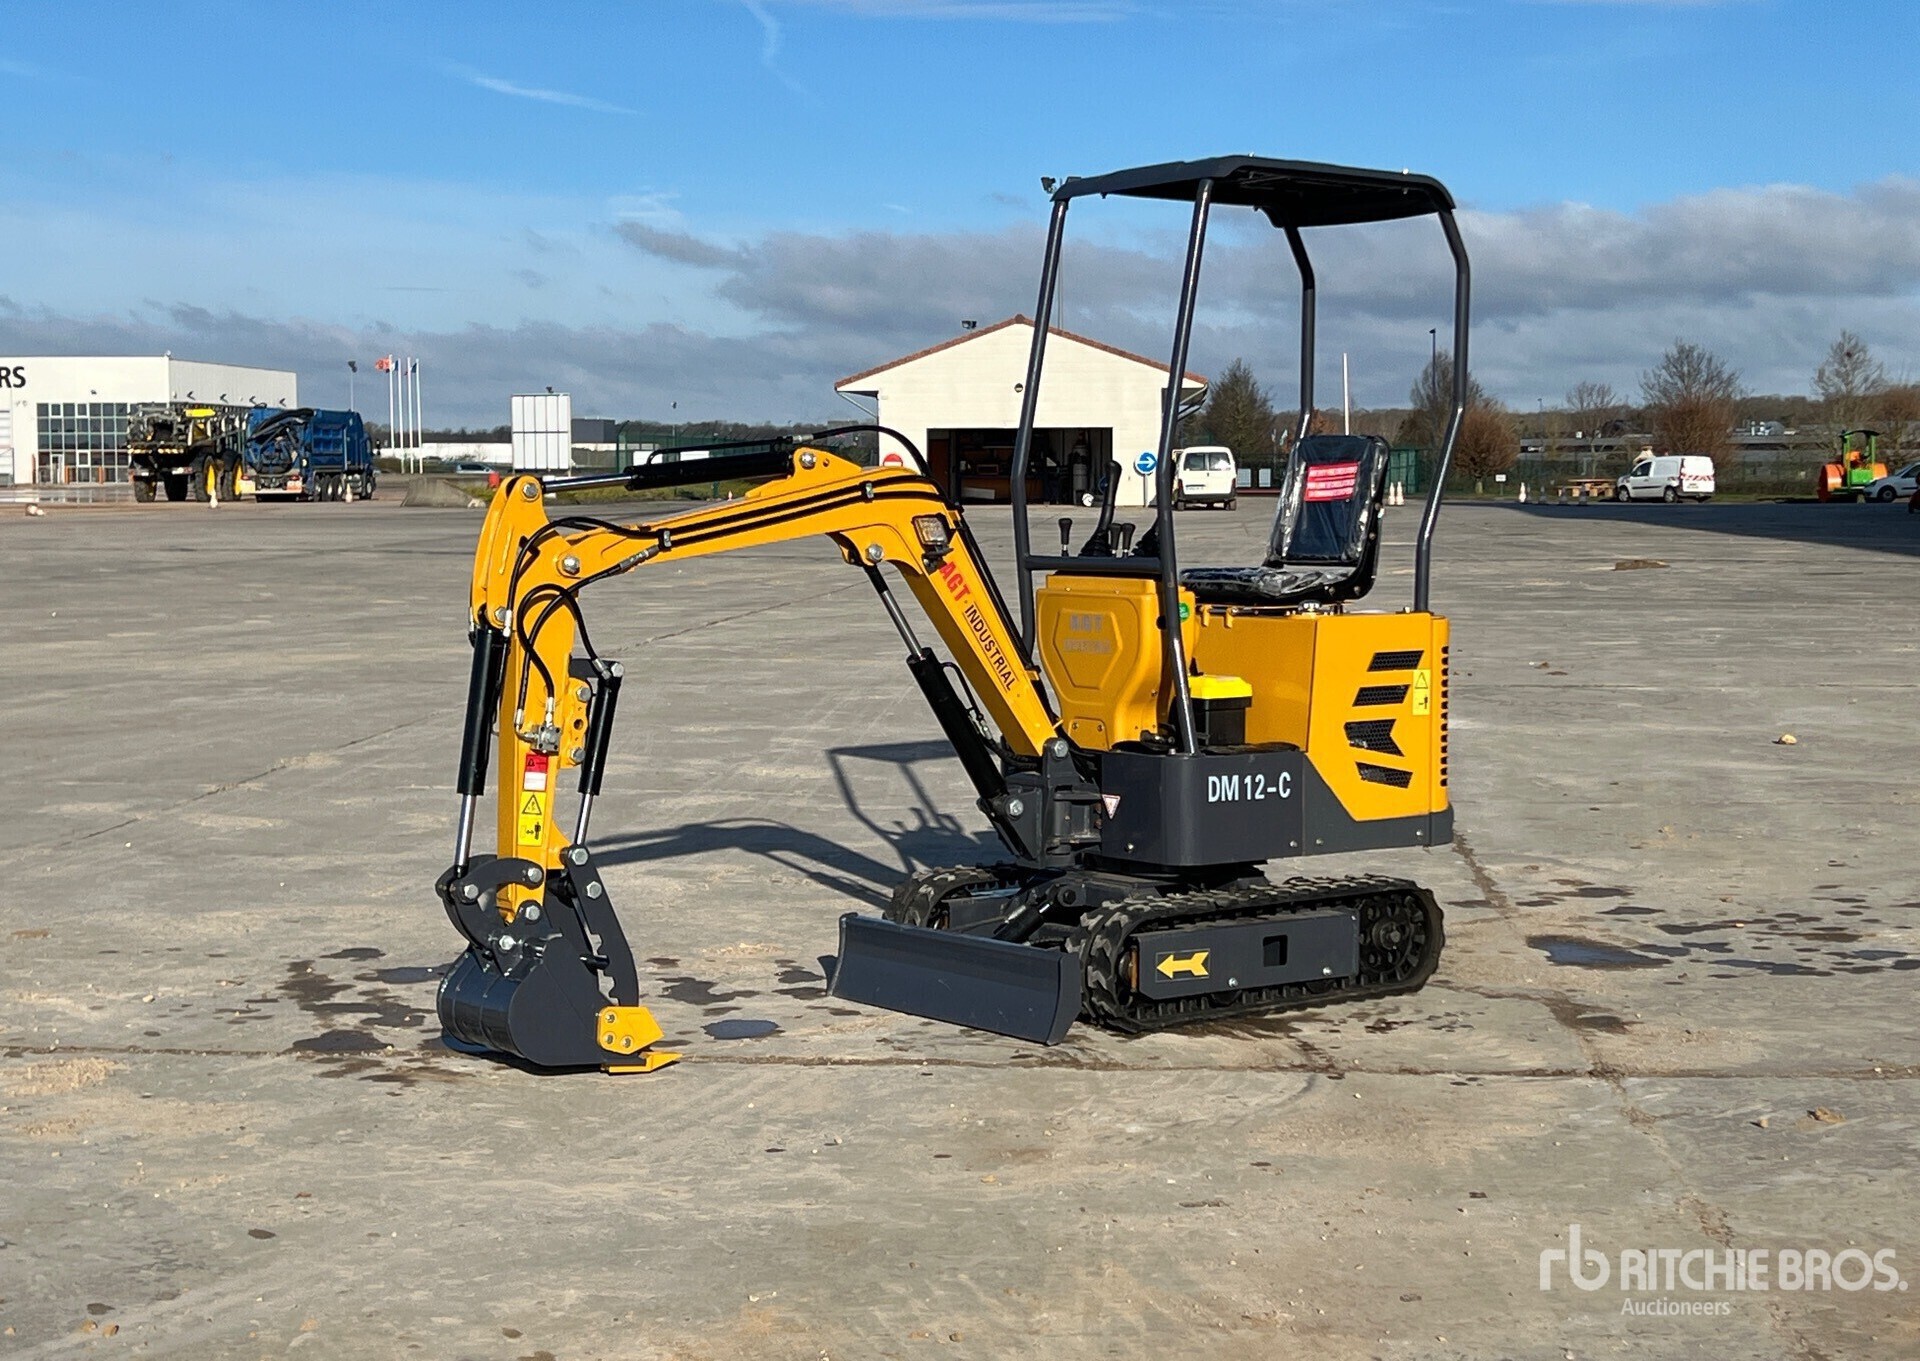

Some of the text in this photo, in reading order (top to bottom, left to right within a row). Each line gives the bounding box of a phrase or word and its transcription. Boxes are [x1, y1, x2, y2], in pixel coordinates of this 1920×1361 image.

[0, 366, 26, 388] RS
[938, 560, 1016, 692] AGT INDUSTRIAL
